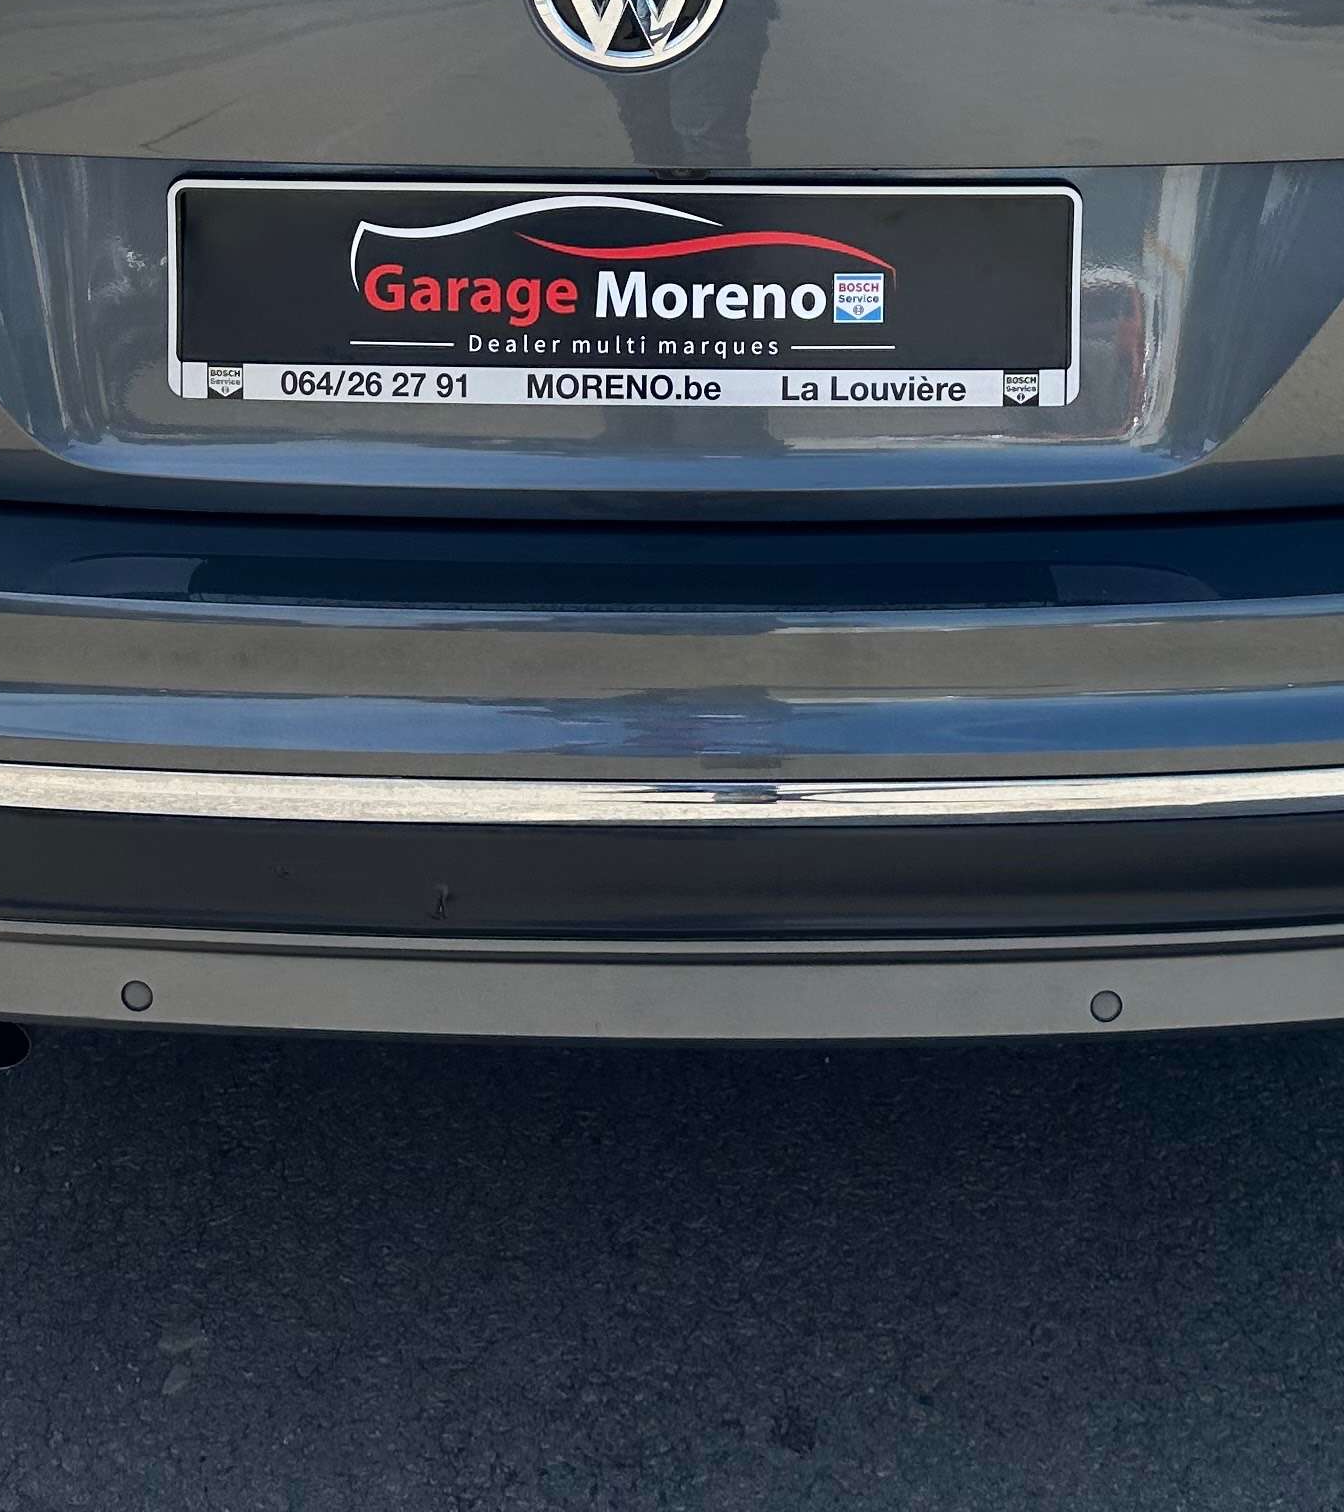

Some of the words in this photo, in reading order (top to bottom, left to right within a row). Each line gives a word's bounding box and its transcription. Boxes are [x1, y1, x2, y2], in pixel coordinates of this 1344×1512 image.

[837, 282, 880, 293] BOSCH
[364, 263, 579, 327] Garage
[595, 270, 828, 320] Moreno
[837, 293, 880, 304] Service
[468, 334, 561, 354] Dealer
[572, 335, 646, 355] multi
[657, 338, 780, 360] marques
[210, 369, 241, 378] BOSCH
[280, 370, 383, 398] 064/26
[391, 372, 427, 398] 27
[435, 373, 469, 399] 91
[527, 374, 722, 402] MORENO.be
[781, 375, 819, 402] La
[830, 374, 968, 402] Louvière
[1006, 376, 1037, 385] BOSCH
